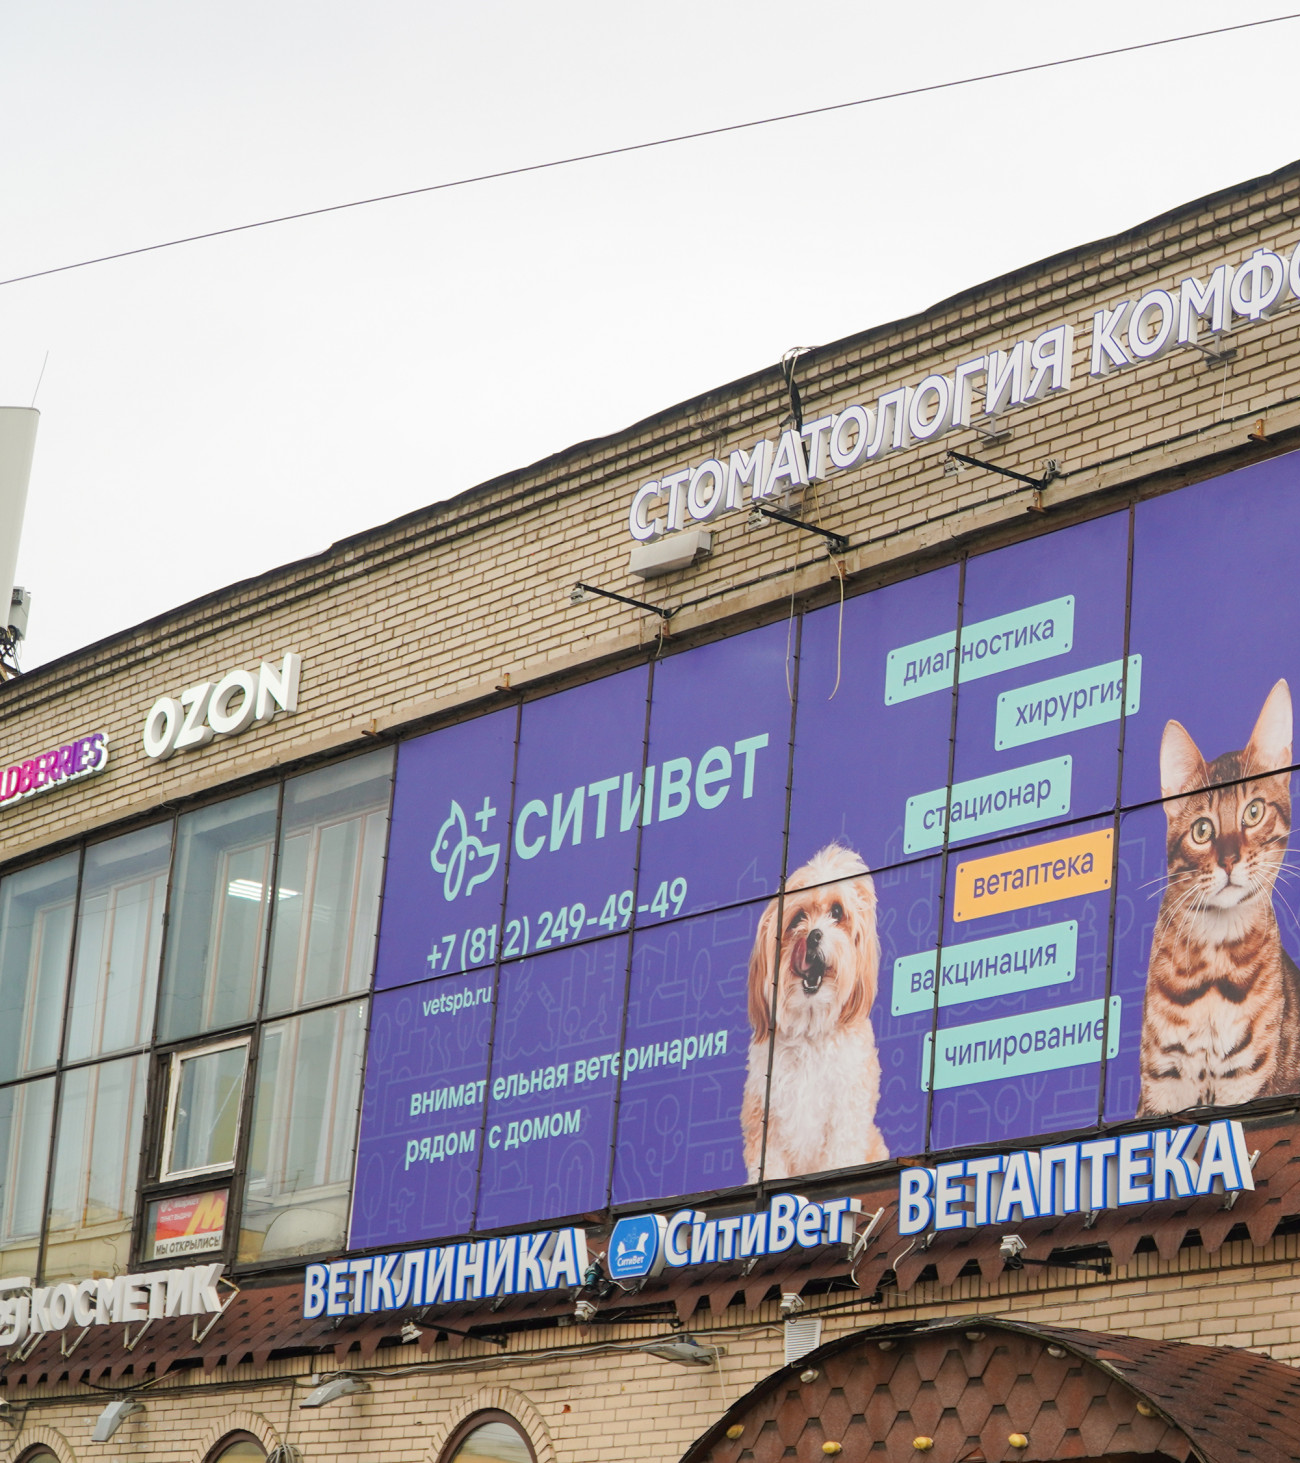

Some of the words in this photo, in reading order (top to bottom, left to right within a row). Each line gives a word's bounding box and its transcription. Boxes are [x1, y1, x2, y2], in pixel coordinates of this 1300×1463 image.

[628, 324, 1074, 543] СТОМАТОЛОГИЯ
[903, 618, 1055, 686] диагностика
[143, 652, 301, 761] OZON
[1015, 678, 1125, 727] хирургия
[922, 779, 1052, 830] стационар
[973, 852, 1094, 899] ветаптека
[427, 934, 456, 971] +7
[461, 916, 529, 975] (812)
[535, 877, 687, 949] 249-49-49
[423, 986, 492, 1016] vetspb.ru
[910, 943, 1057, 994] вакцинация
[409, 1063, 568, 1116] внимательная
[574, 1030, 728, 1084] ветеринария
[944, 1018, 1105, 1067] чипирование
[405, 1129, 475, 1170] рядом
[488, 1125, 501, 1149] с
[505, 1109, 581, 1150] домом
[898, 1119, 1255, 1236] ВЕТАПТЕКА
[664, 1193, 862, 1269] СитиВет
[31, 1263, 226, 1335] КОСМЕТИК
[303, 1227, 588, 1320] ВЕТКЛИНИКА
